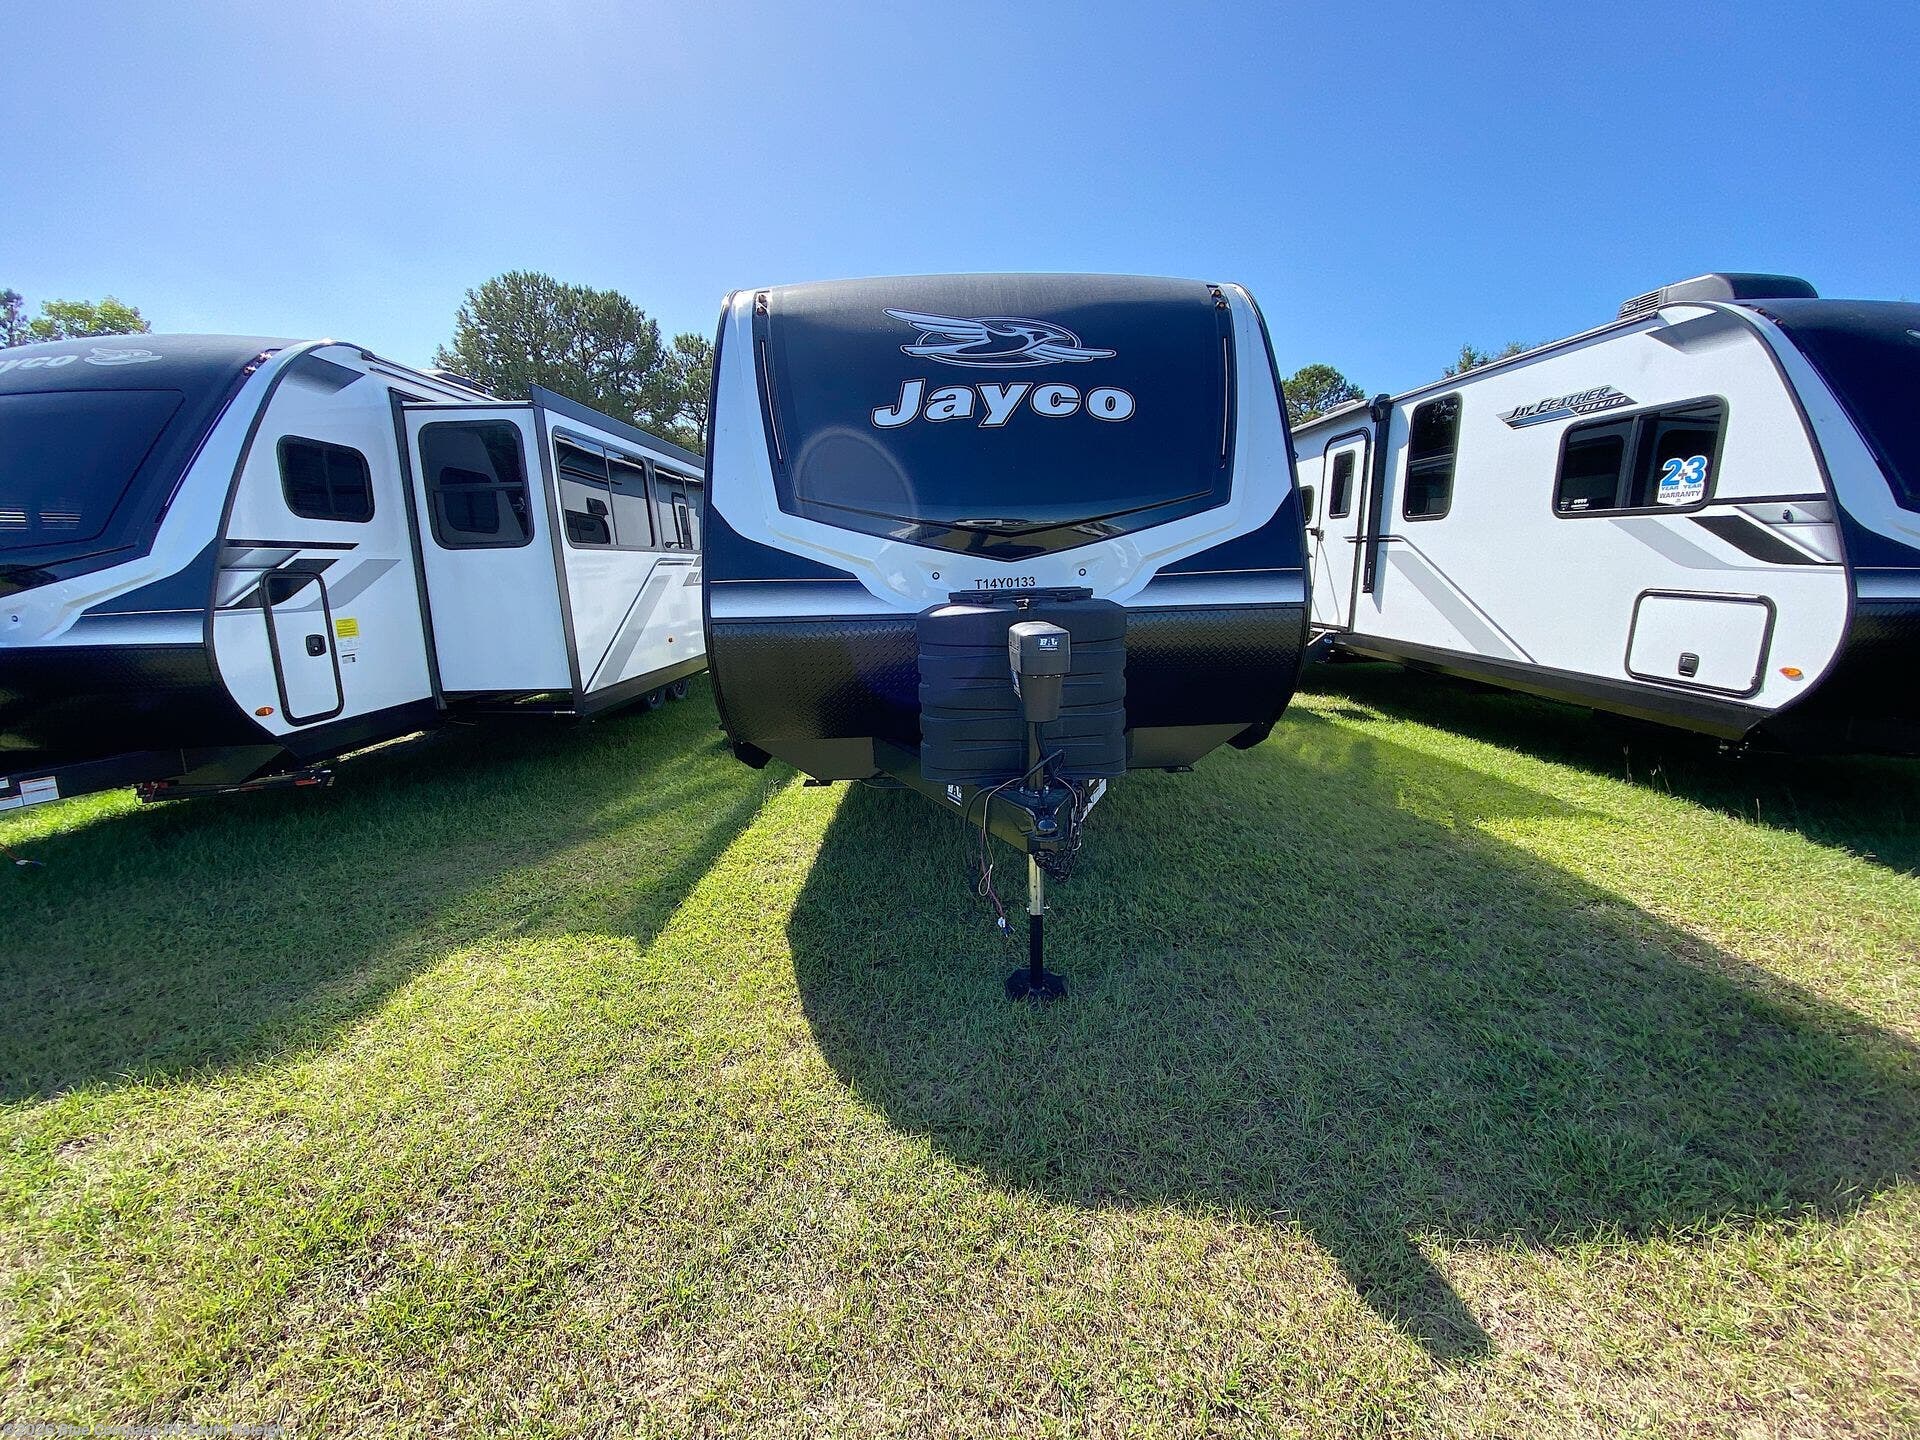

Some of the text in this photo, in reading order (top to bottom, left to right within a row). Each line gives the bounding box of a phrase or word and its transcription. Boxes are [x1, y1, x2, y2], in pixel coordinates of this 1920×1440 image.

[871, 378, 1136, 428] Jayco
[1506, 385, 1612, 420] JAY FEATHER
[1577, 396, 1626, 413] PREMIER
[975, 577, 1036, 589] T14Y0133
